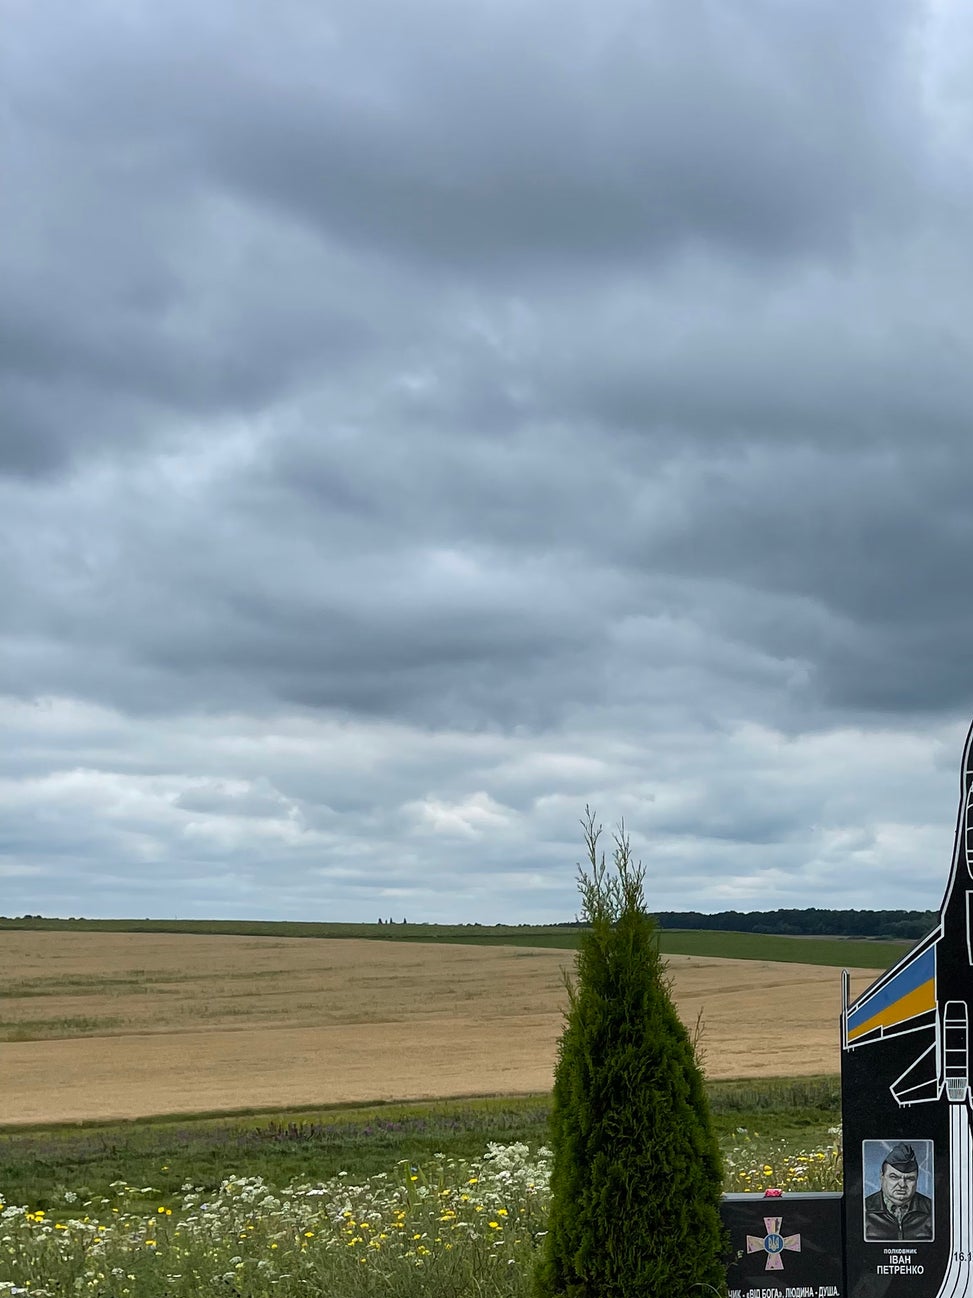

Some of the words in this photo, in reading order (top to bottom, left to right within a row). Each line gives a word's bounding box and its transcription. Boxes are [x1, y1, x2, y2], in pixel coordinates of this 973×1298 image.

[889, 1255, 911, 1264] ІВАН
[877, 1265, 924, 1274] ПЕТРЕНКО
[785, 1287, 814, 1298] ЛЮДИНА
[818, 1286, 840, 1298] ДУША.
